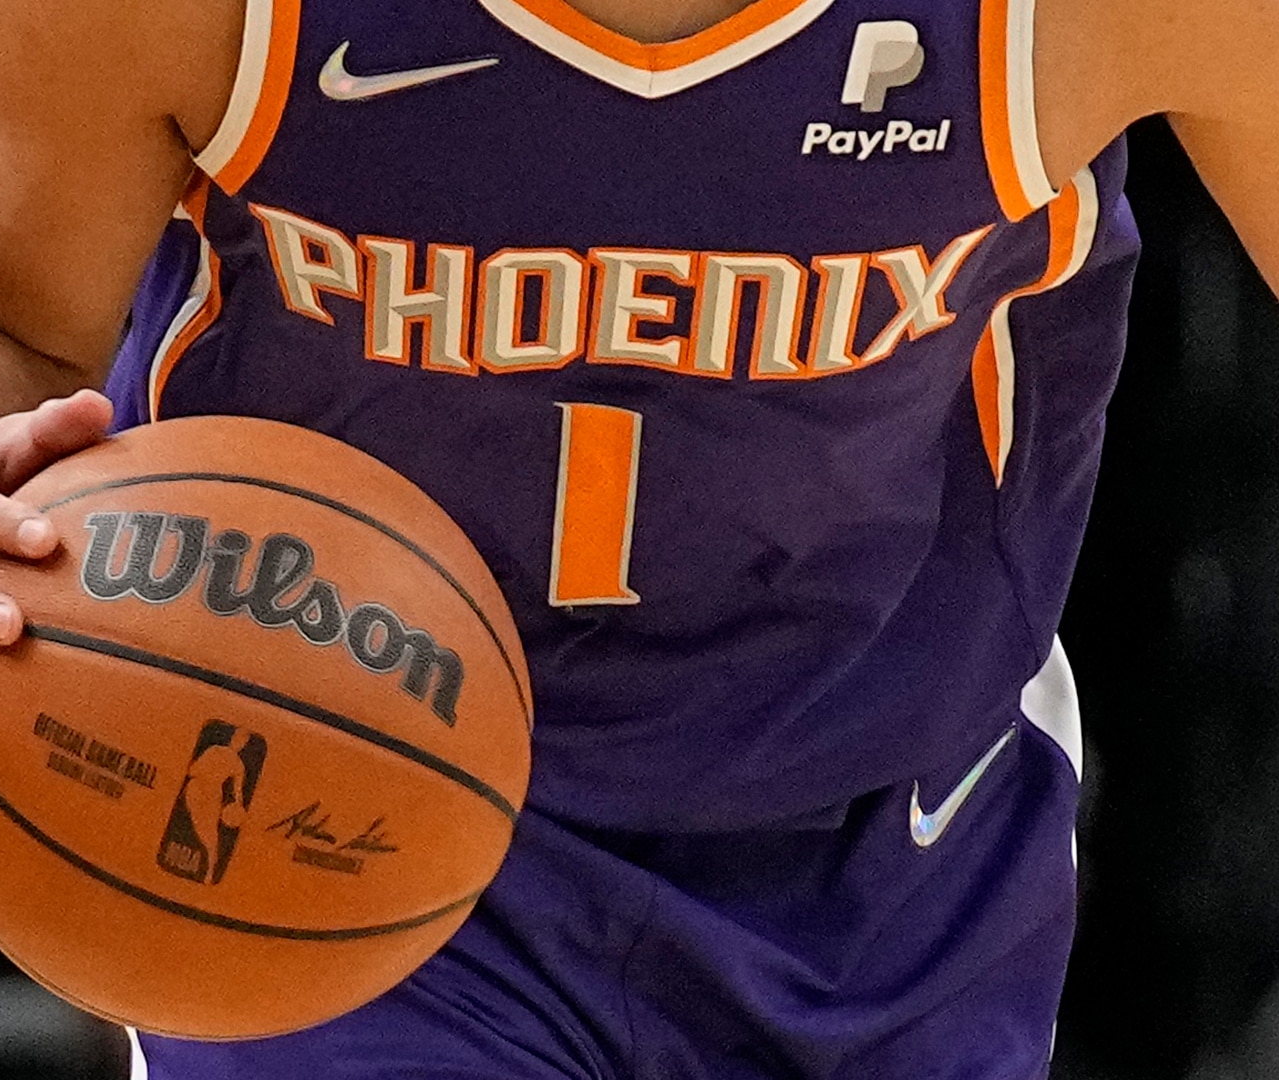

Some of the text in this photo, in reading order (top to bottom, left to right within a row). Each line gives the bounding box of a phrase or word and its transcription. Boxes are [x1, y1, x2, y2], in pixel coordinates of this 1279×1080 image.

[801, 119, 951, 161] PayPal
[248, 203, 996, 380] PHOENIX
[549, 402, 641, 607] 1
[80, 511, 465, 728] Wilson
[123, 756, 157, 790] BALL
